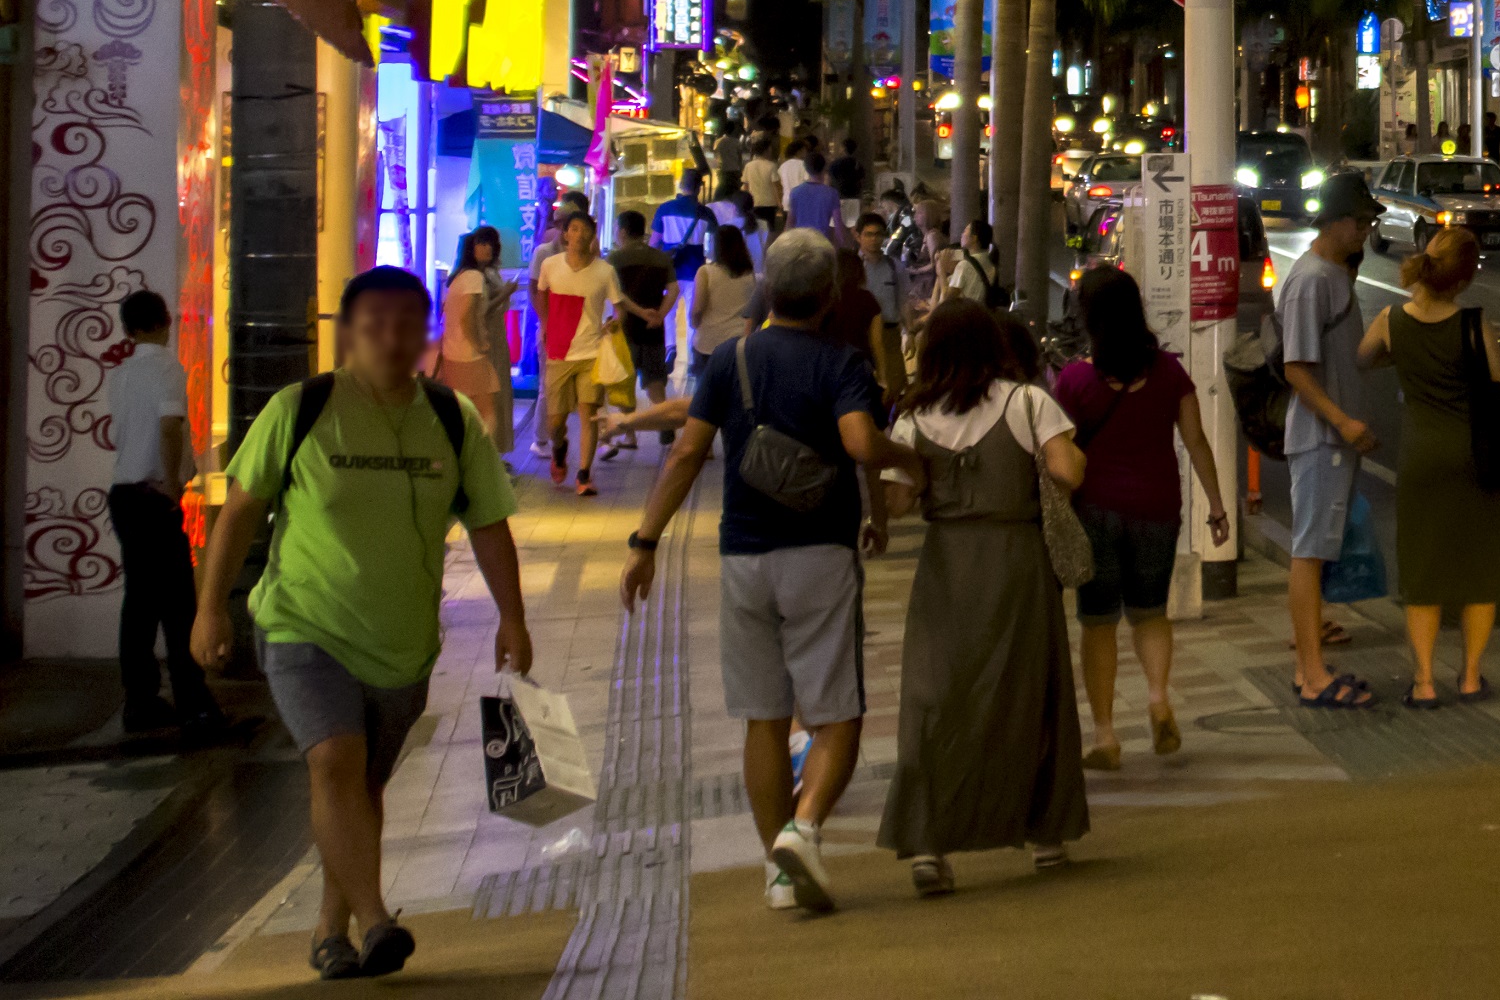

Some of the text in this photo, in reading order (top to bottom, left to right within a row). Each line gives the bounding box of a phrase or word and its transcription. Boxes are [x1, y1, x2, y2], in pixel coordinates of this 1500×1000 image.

[1158, 199, 1175, 281] 市場本通り
[1191, 231, 1235, 272] 4 m
[330, 455, 431, 470] QUIKSILVER
